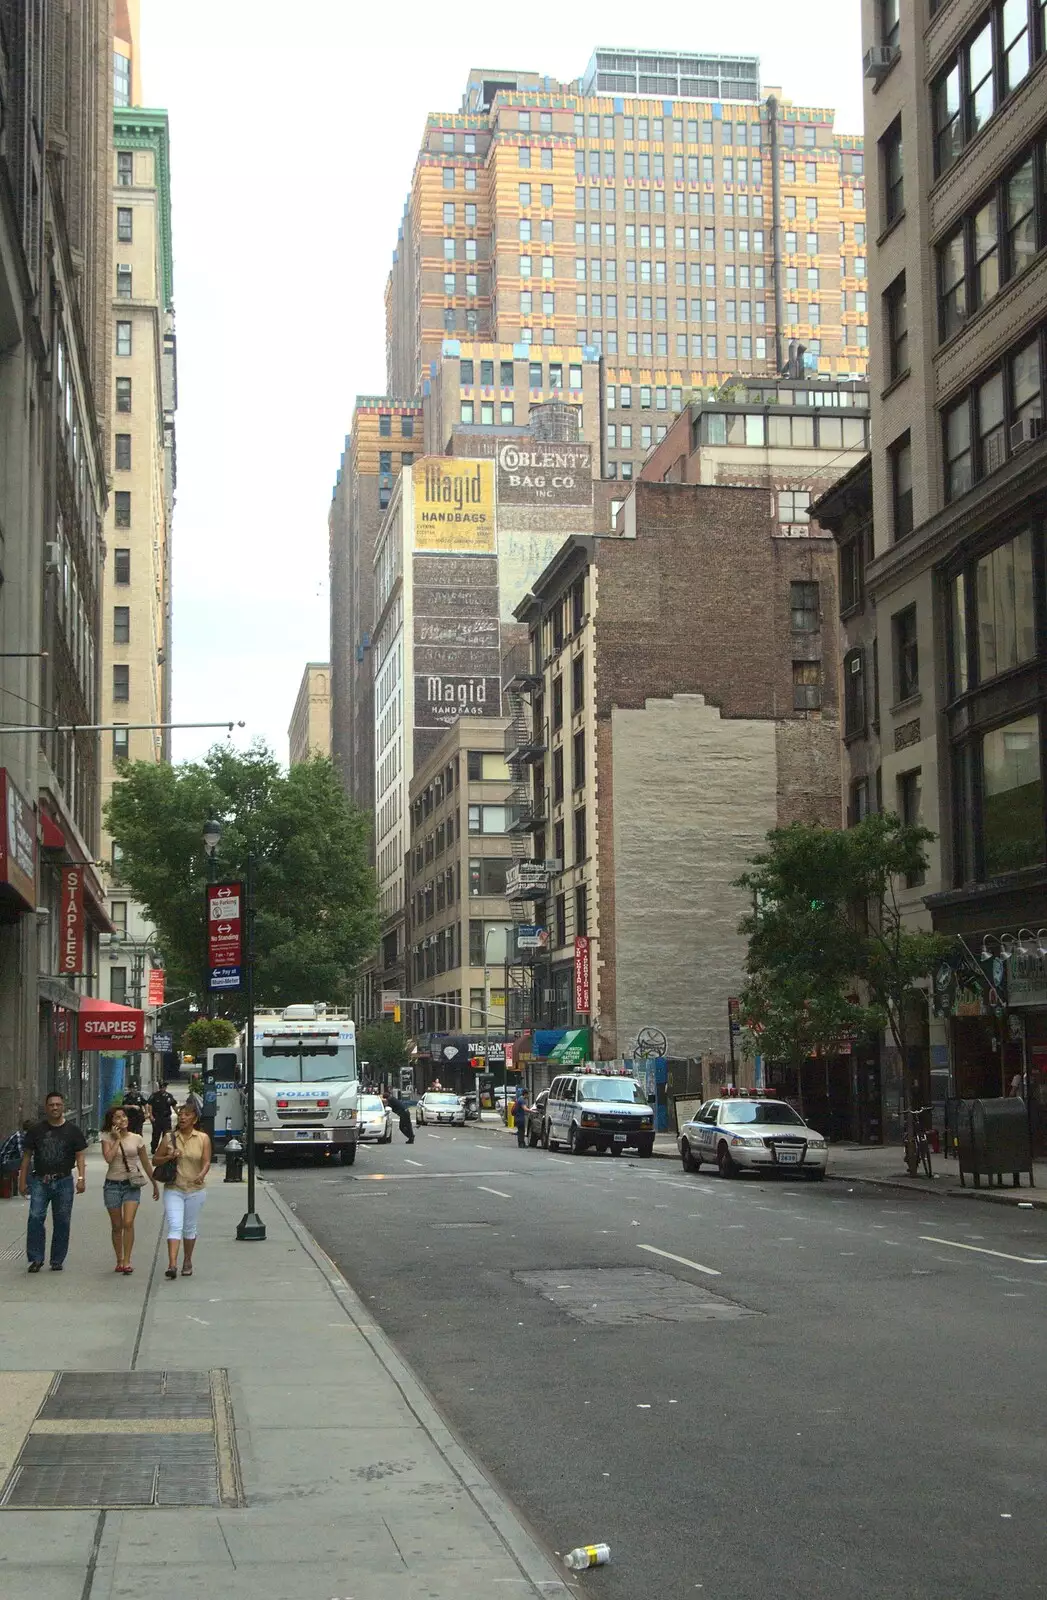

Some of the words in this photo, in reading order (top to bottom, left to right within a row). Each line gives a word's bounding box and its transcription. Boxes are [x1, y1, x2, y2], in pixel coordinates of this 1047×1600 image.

[425, 463, 480, 510] Magid
[509, 475, 545, 487] BAG
[552, 477, 576, 488] CO.
[536, 490, 555, 498] INC.
[422, 512, 486, 522] HANDBAGS
[427, 676, 486, 707] Magid
[65, 872, 78, 969] STAPLES
[84, 1021, 137, 1033] STAPLES
[208, 1076, 214, 1084] P
